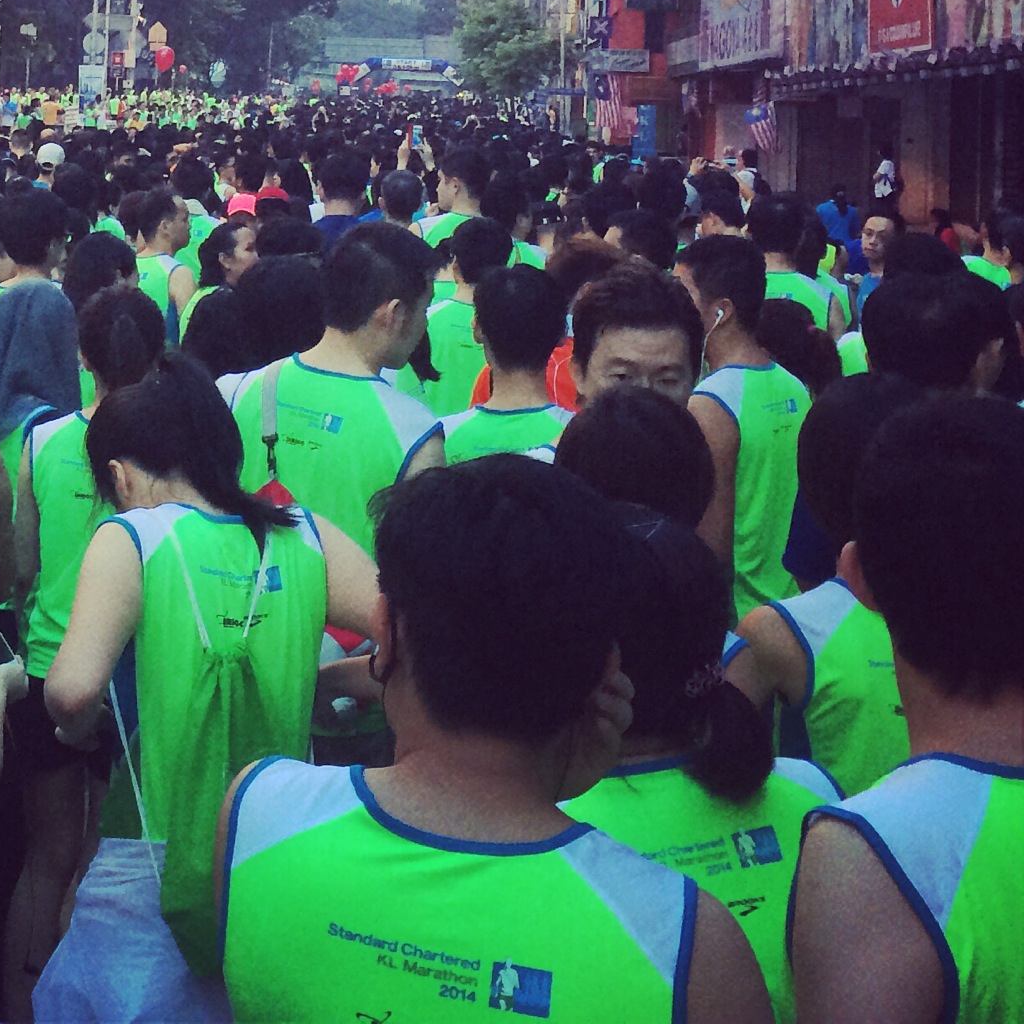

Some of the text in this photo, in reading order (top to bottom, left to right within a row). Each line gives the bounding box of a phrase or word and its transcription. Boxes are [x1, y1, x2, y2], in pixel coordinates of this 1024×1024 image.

[327, 922, 481, 971] Standard Chartered
[376, 953, 478, 988] KL Marathon
[438, 984, 477, 1003] 2014
